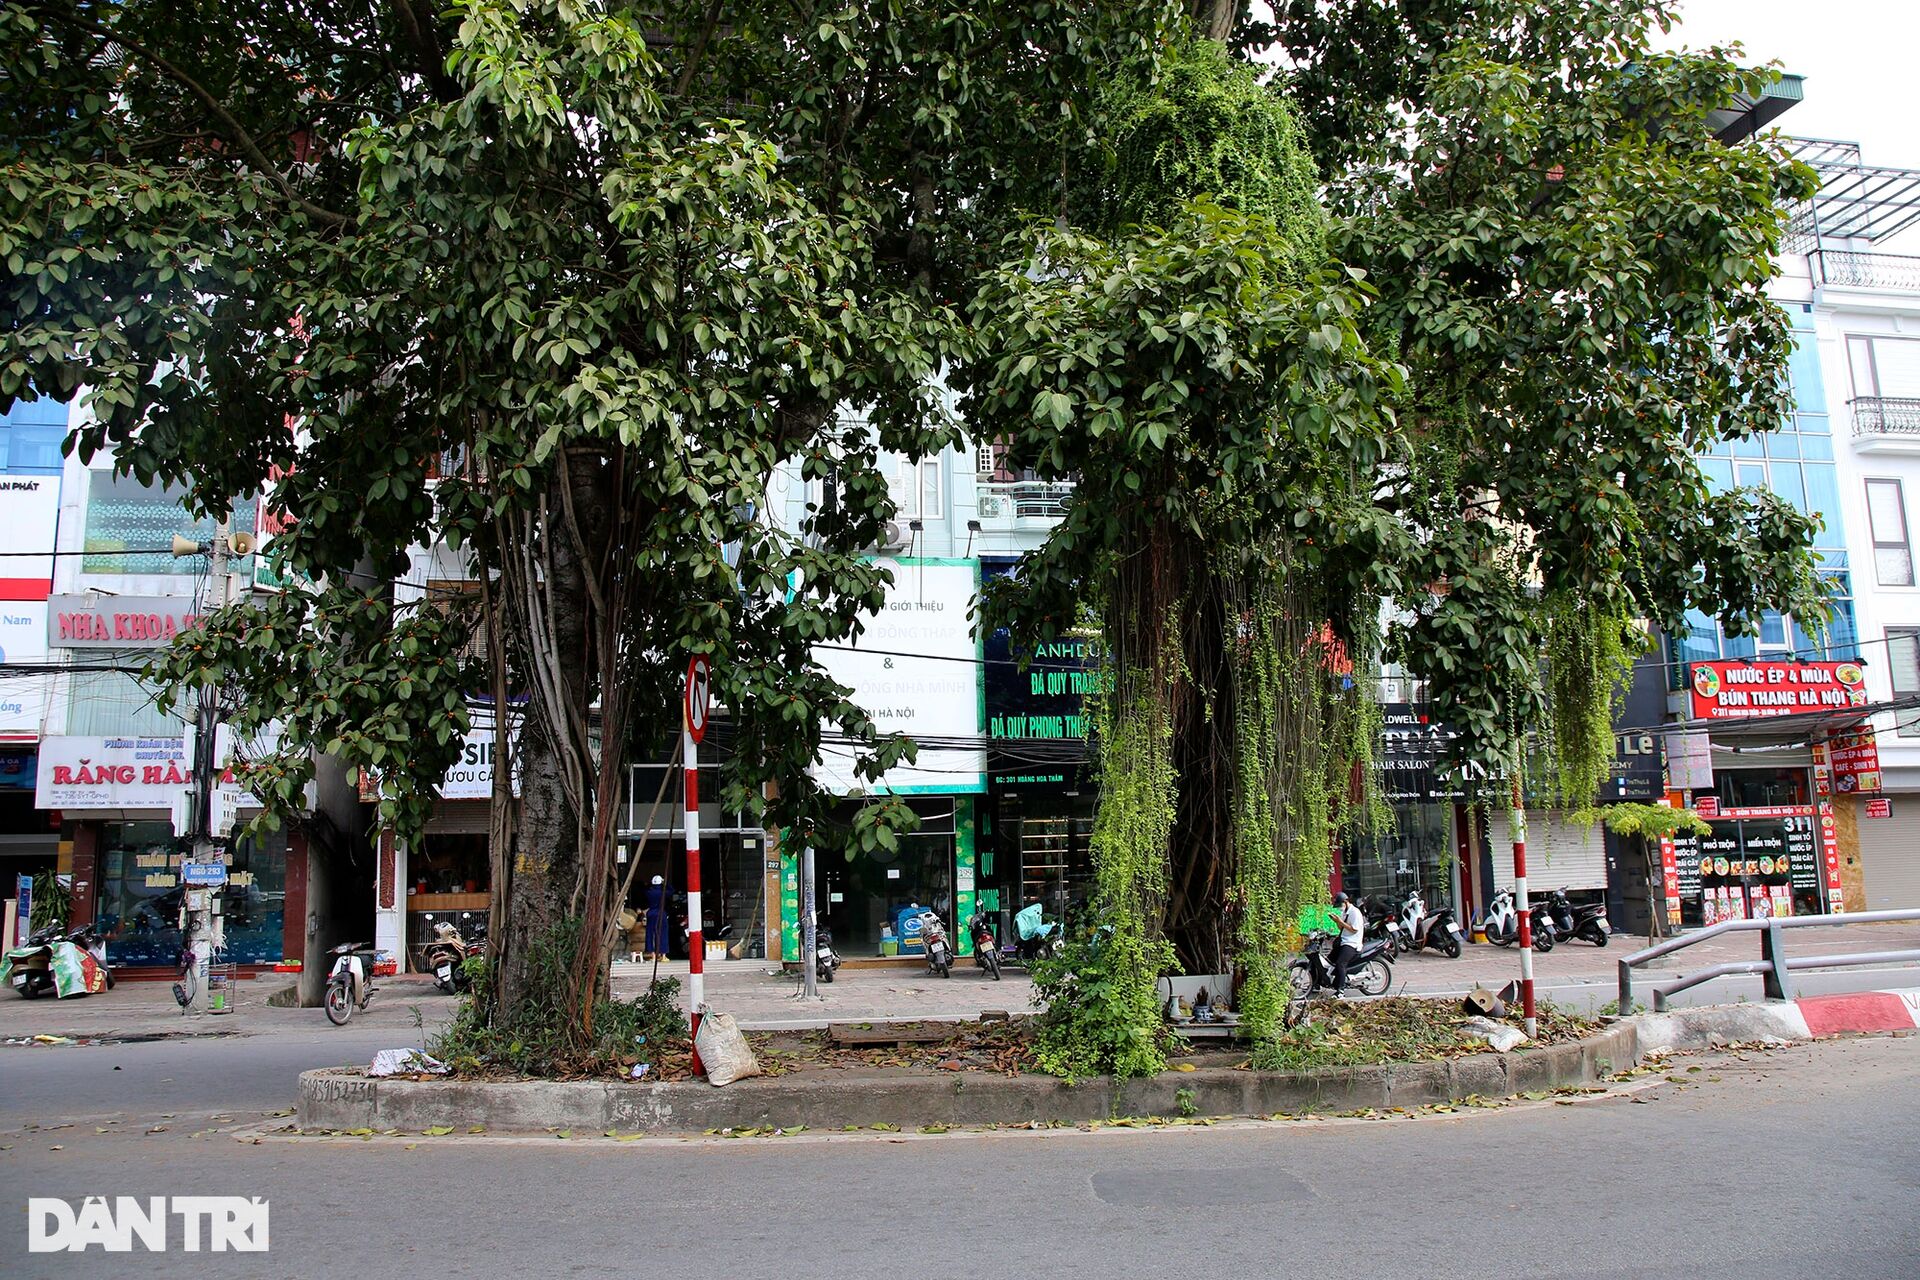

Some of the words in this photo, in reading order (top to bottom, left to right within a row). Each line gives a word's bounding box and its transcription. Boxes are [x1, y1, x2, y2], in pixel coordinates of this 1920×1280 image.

[12, 480, 40, 491] PHÁT
[890, 600, 912, 611] GIỚI
[916, 602, 944, 614] THIỆU
[3, 615, 32, 625] Nam
[58, 613, 110, 640] NHA
[114, 613, 178, 641] KHOA
[883, 657, 894, 669] &
[1726, 666, 1764, 684] NƯỚC
[1767, 665, 1785, 684] ÉP
[1788, 670, 1798, 684] 4
[1801, 667, 1833, 684] MÙA
[1031, 669, 1045, 695] ĐÁ
[1048, 668, 1066, 697] QUÝ
[1718, 687, 1748, 706] BÚN
[1751, 690, 1796, 706] THANG
[1800, 686, 1819, 705] HÀ
[1821, 686, 1846, 708] NỘI
[879, 706, 893, 718] HÀ
[896, 706, 915, 720] NỘI
[991, 713, 1005, 739] ĐÁ
[1007, 712, 1027, 739] QUÝ
[1029, 716, 1063, 739] PHONG
[136, 738, 162, 749] KHÁM
[164, 738, 184, 750] BỆN
[135, 750, 170, 760] CHUYÊN
[53, 758, 136, 785] RĂNG
[1397, 760, 1429, 770] SALON
[446, 770, 475, 784] ƯƠU
[1784, 816, 1812, 832] 311
[1718, 838, 1736, 851] TRỘN
[1764, 837, 1782, 849] TRỘN
[207, 867, 221, 875] 293
[768, 861, 780, 869] 297
